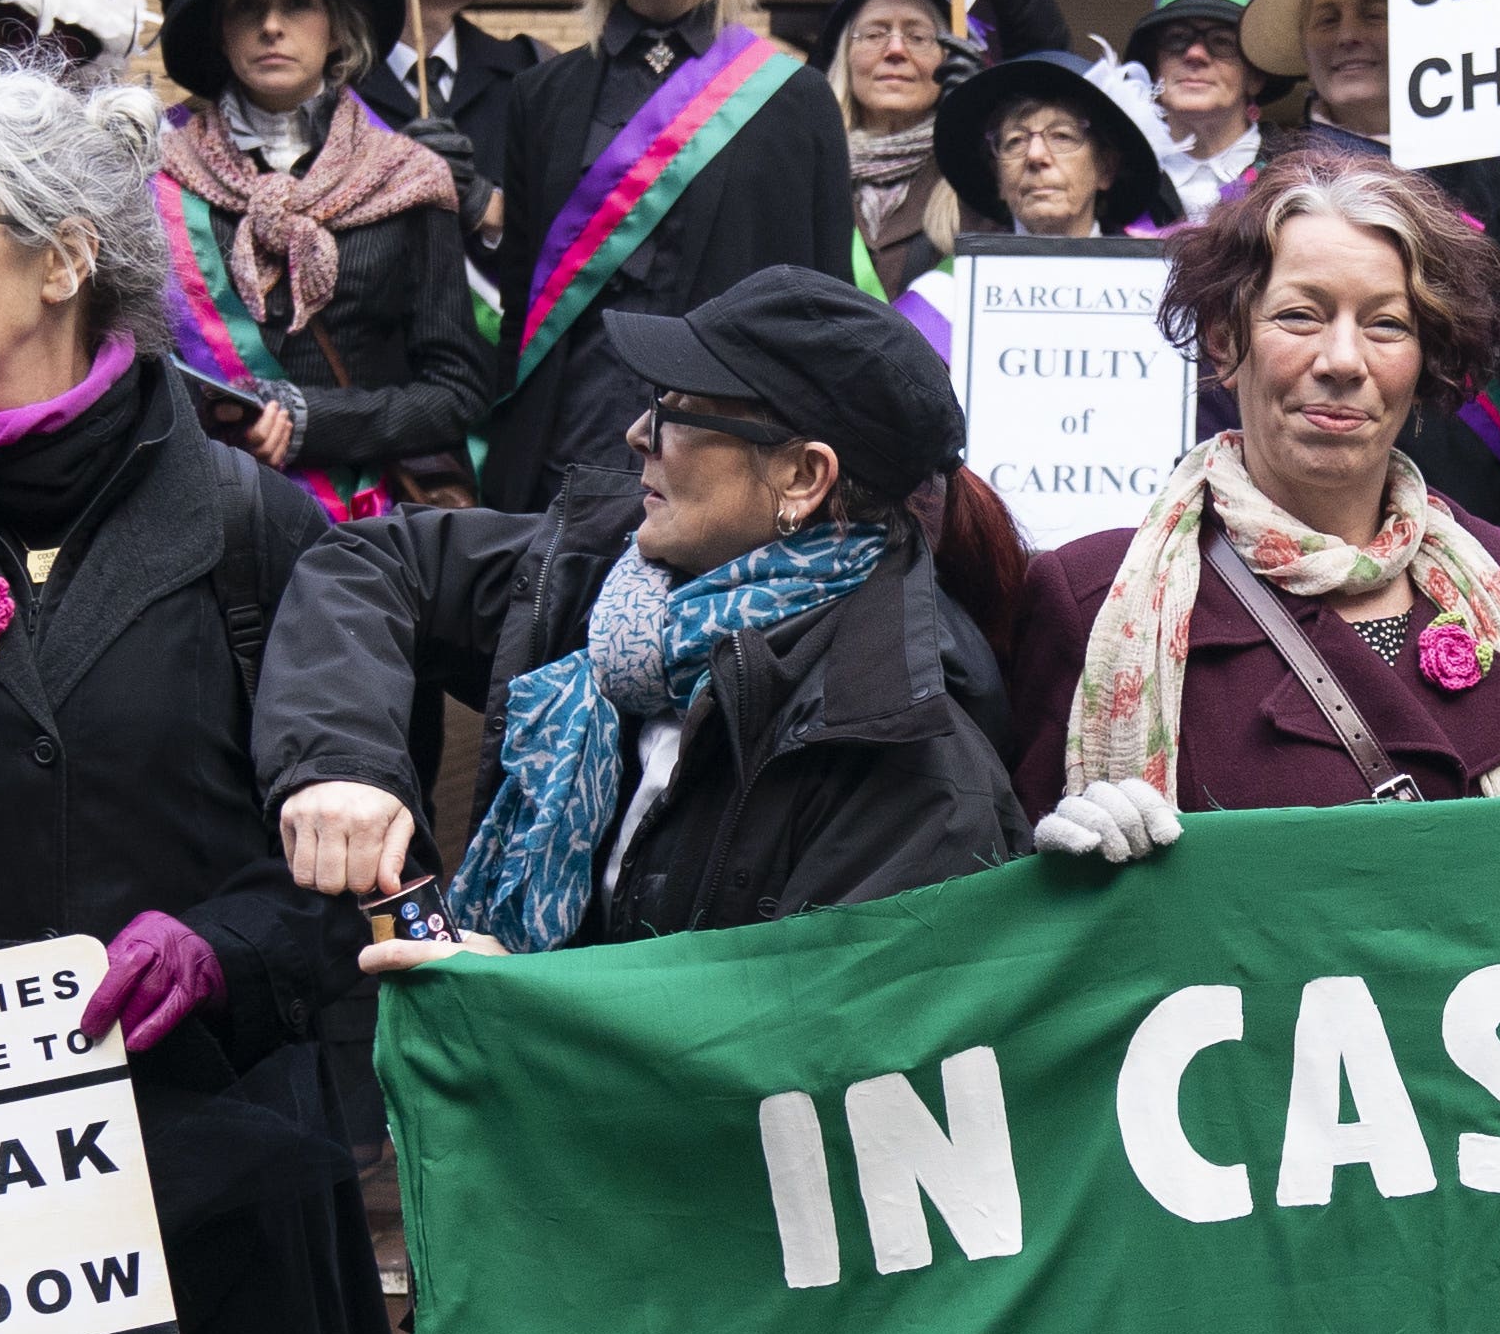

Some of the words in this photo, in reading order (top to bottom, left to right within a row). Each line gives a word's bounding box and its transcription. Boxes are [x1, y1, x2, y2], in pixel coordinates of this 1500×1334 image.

[985, 285, 1154, 314] BARCLAYS
[998, 347, 1158, 380] GUILTY
[1061, 408, 1096, 435] of
[989, 463, 1159, 497] CARING
[33, 1028, 96, 1061] TO
[758, 1044, 1023, 1290] IN
